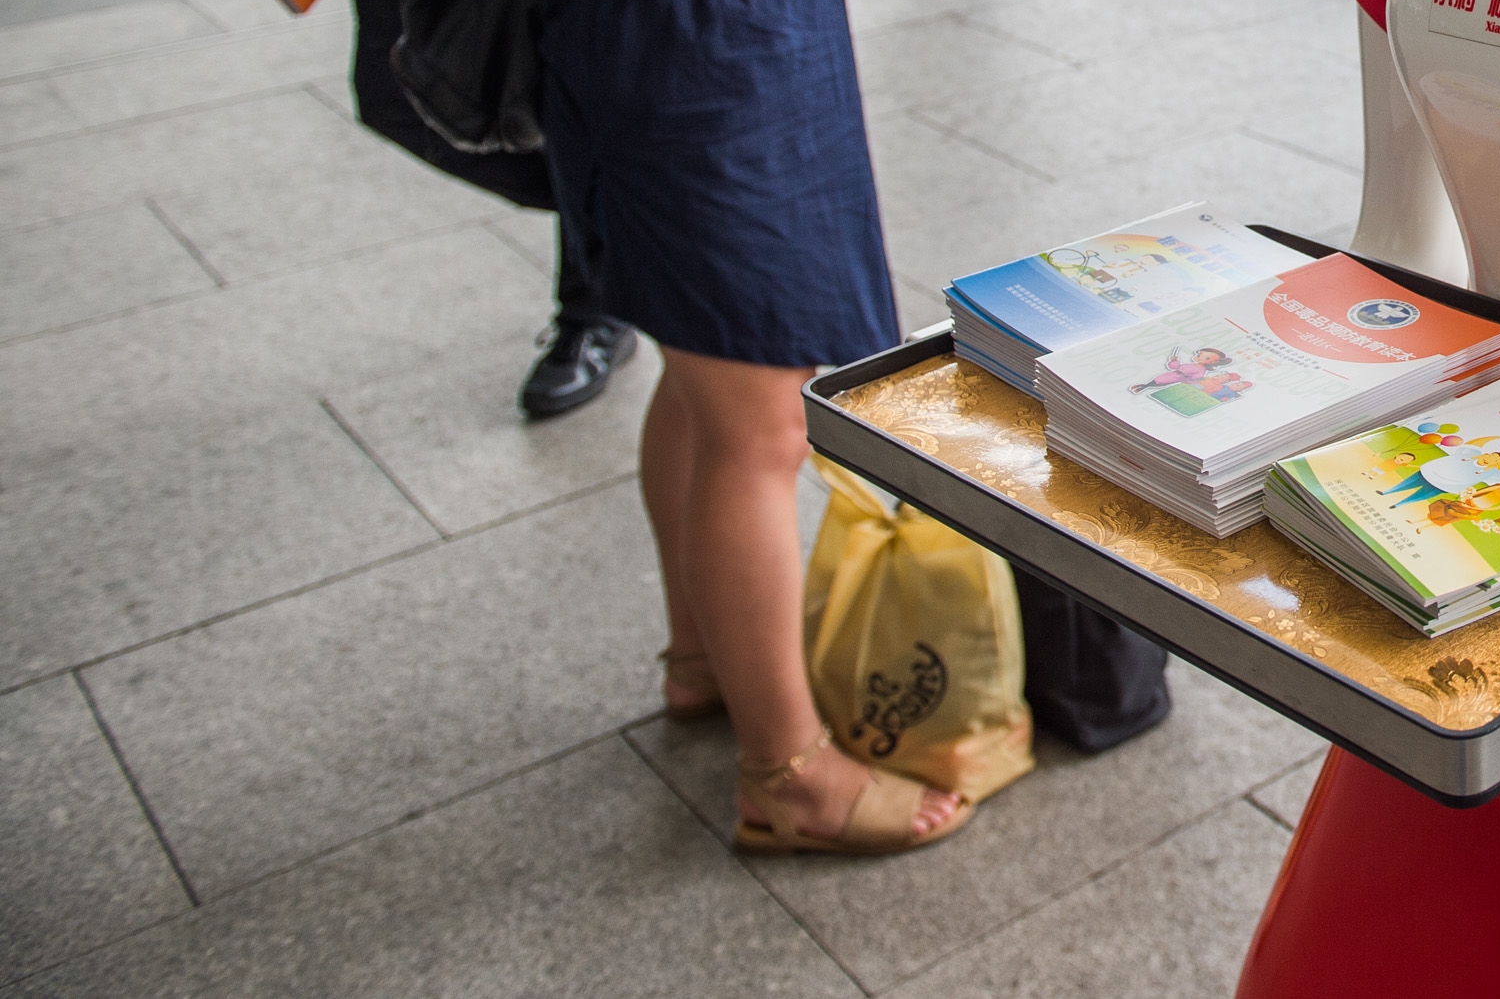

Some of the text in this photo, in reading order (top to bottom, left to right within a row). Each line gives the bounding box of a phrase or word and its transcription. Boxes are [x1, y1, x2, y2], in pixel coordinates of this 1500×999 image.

[1267, 292, 1417, 362] 全国毒品预防教育读本
